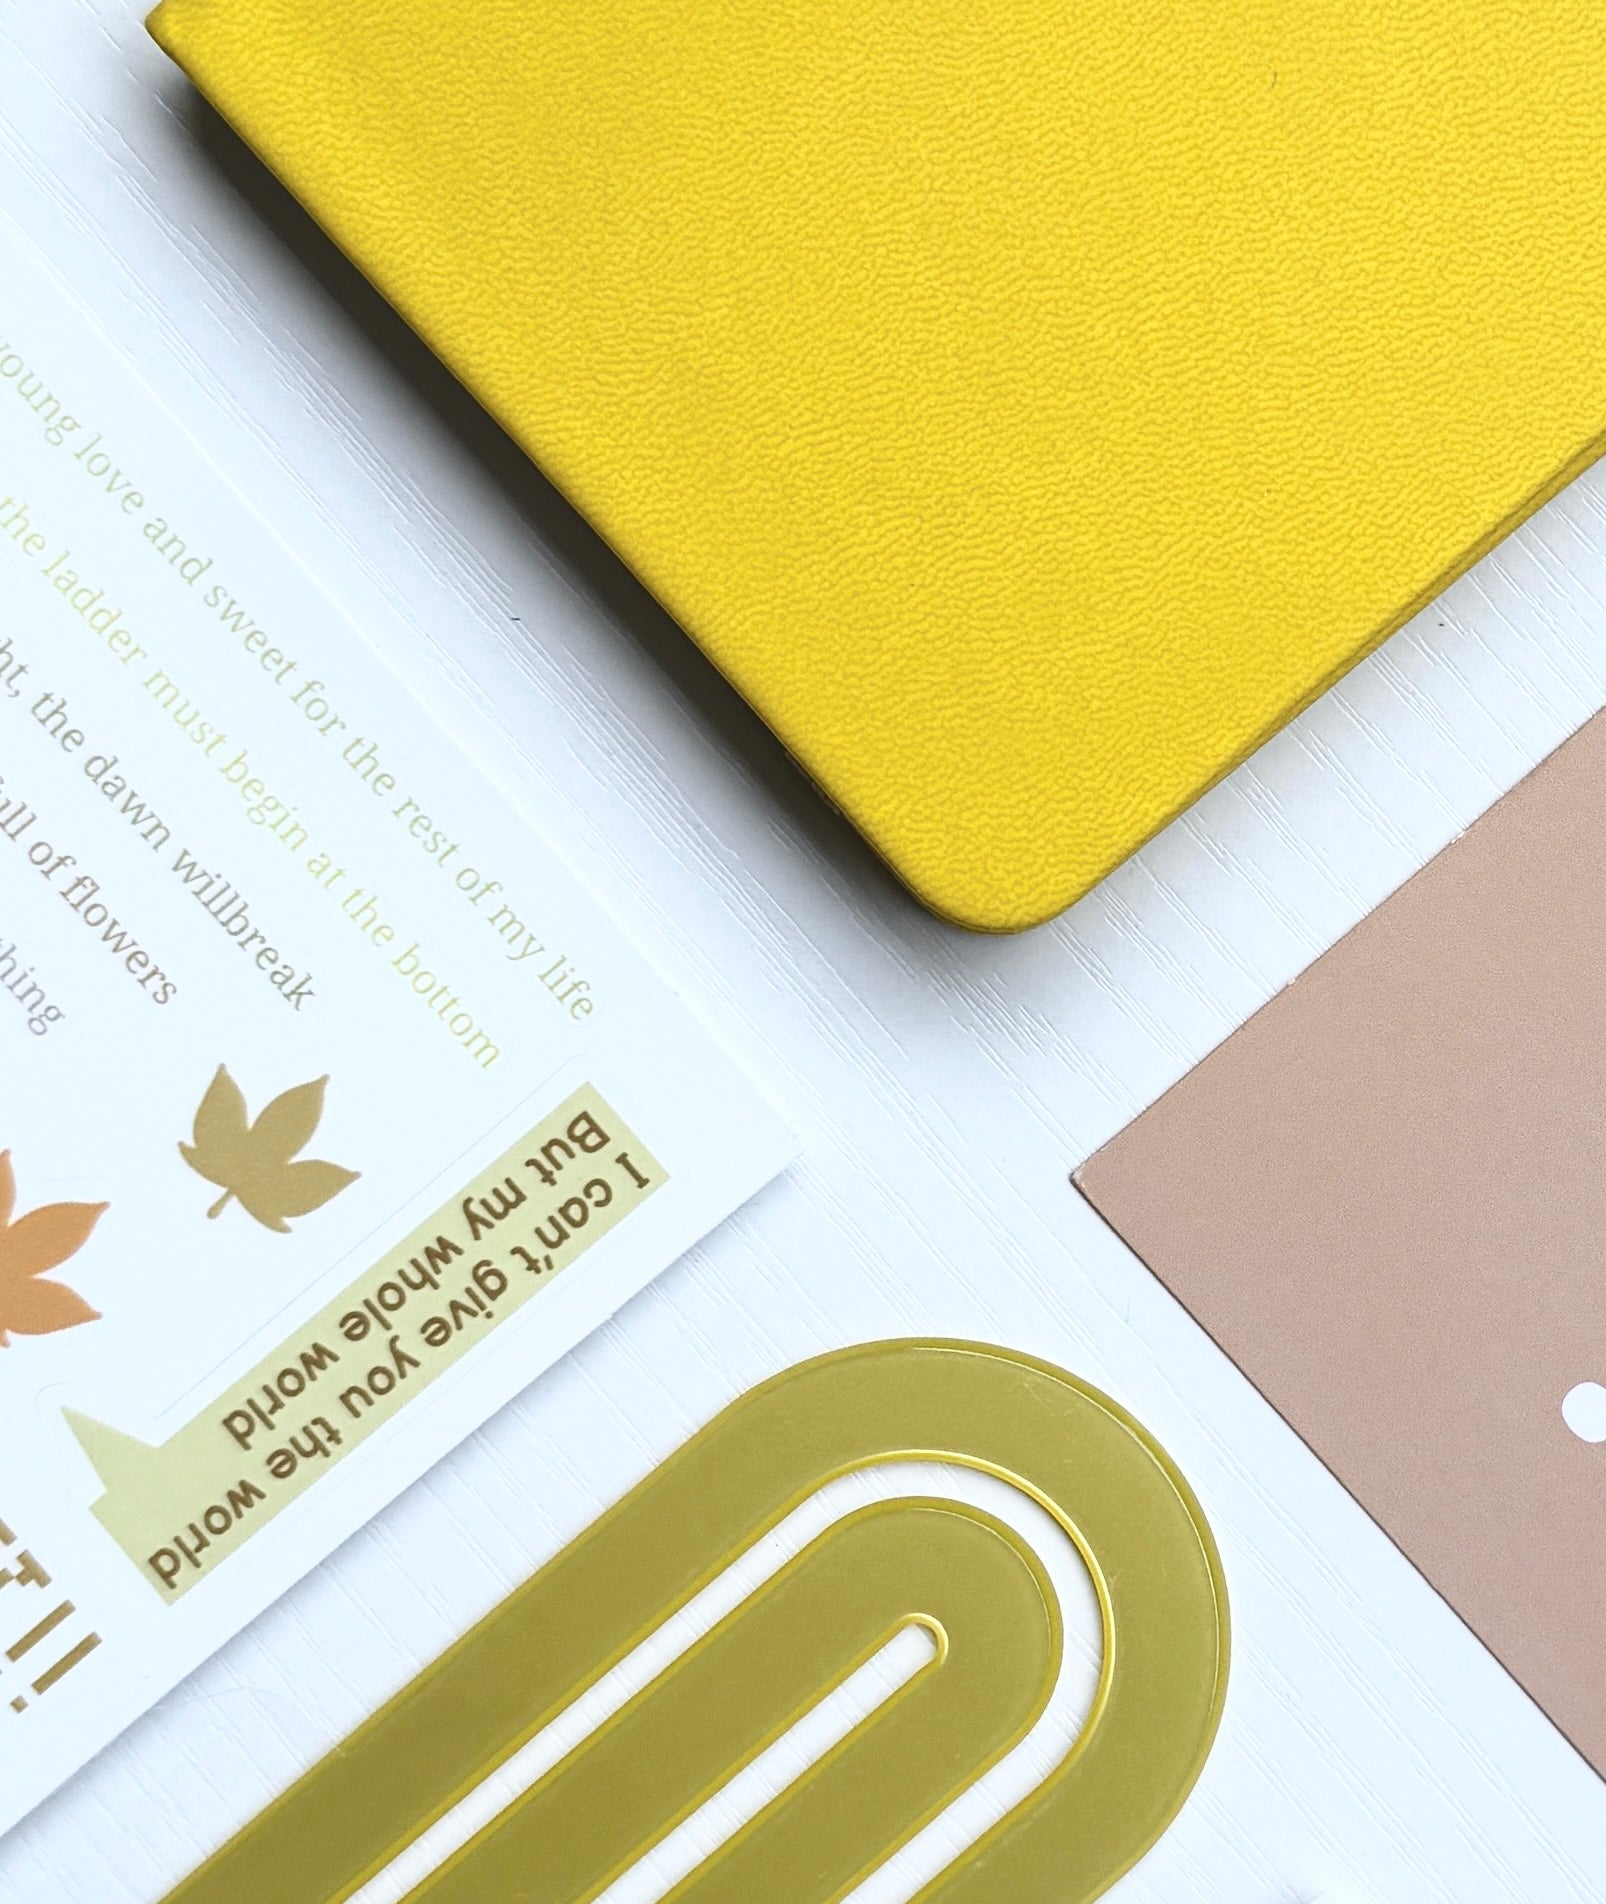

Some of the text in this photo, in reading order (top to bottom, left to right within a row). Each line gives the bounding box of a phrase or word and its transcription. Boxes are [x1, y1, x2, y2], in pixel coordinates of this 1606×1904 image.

[26, 839, 78, 882] of
[56, 874, 179, 1006] flowers
[29, 691, 87, 755] the
[82, 753, 172, 854] dawn
[39, 549, 149, 666] ladder
[141, 668, 228, 758] must
[217, 748, 310, 854] begin
[304, 851, 347, 891] at
[340, 887, 396, 948] the
[389, 941, 502, 1070] bottom
[71, 432, 146, 515] love
[141, 516, 215, 588] and
[202, 584, 299, 687] sweet
[288, 679, 348, 738] for
[341, 735, 397, 798] the
[390, 795, 461, 869] rest
[454, 866, 505, 908] of
[485, 902, 547, 962] my
[536, 953, 595, 1022] life
[146, 1151, 651, 1591] I can't give you the world
[220, 1109, 612, 1452] But my whole world
